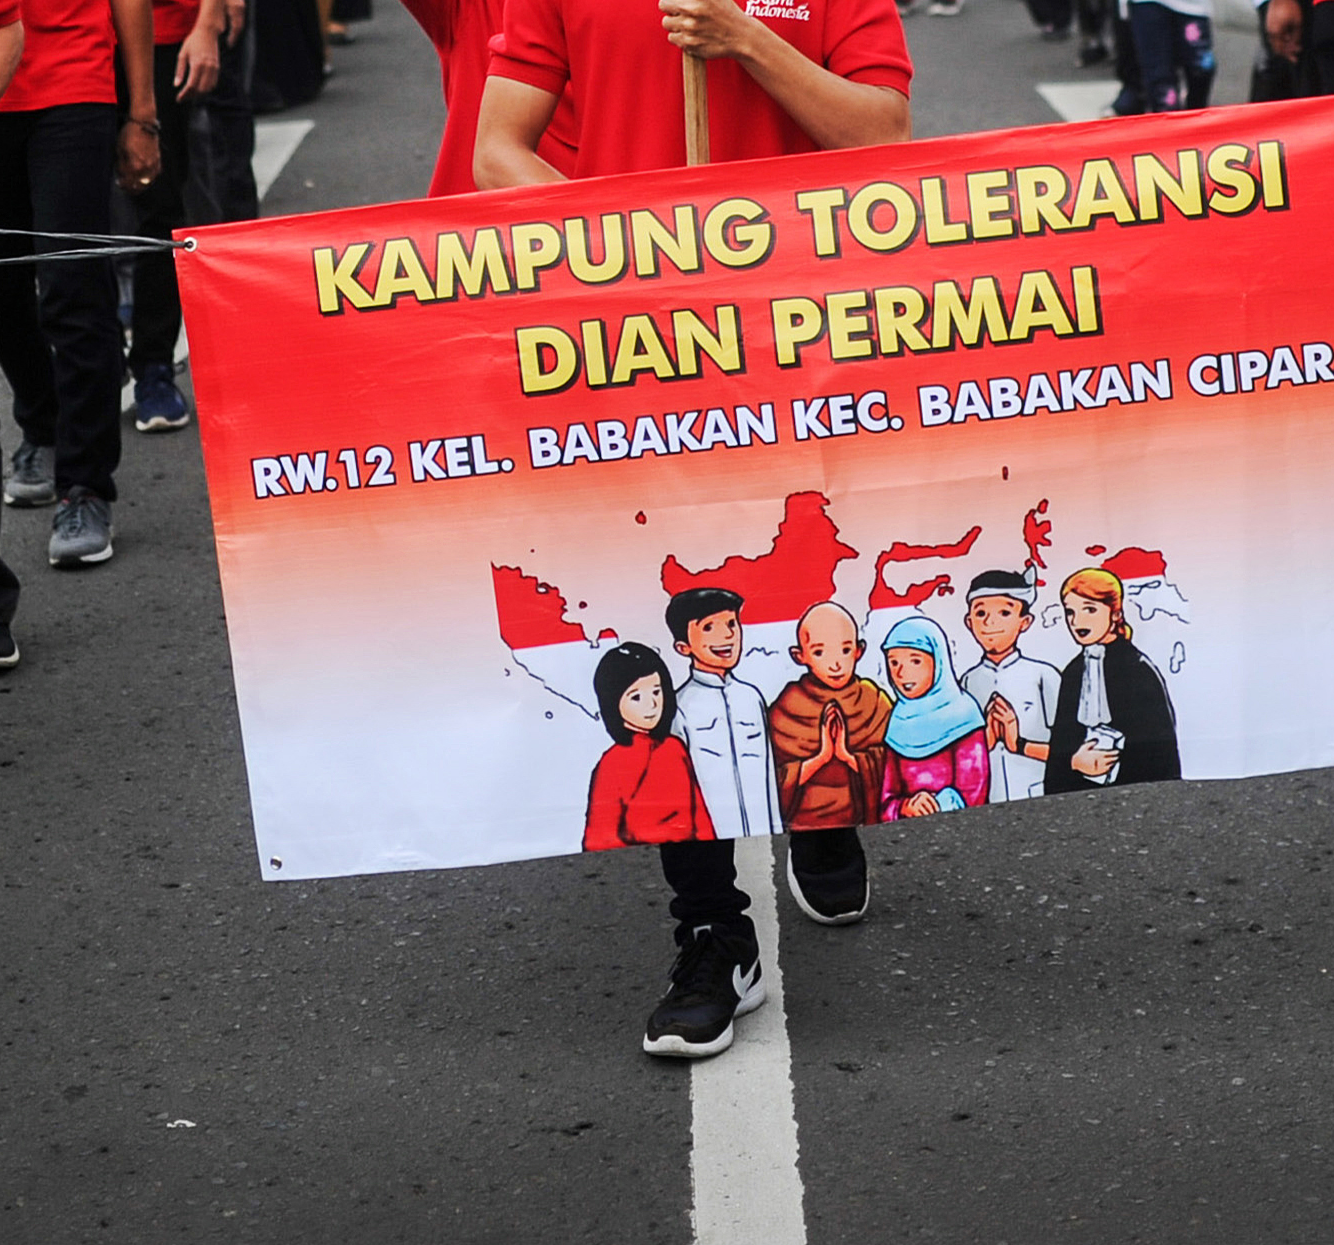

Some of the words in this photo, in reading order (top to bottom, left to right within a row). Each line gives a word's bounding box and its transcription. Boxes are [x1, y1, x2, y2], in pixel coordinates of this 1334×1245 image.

[313, 197, 774, 314] KAMPUNG
[797, 141, 1287, 257] TOLERANSI
[515, 304, 743, 394] DIAN
[772, 264, 1101, 367] PERMAI
[251, 446, 397, 498] RW.12
[409, 434, 514, 482] KEL.
[527, 403, 778, 469] BABAKAN
[792, 391, 904, 441] KEC.
[918, 359, 1172, 427] BABAKAN
